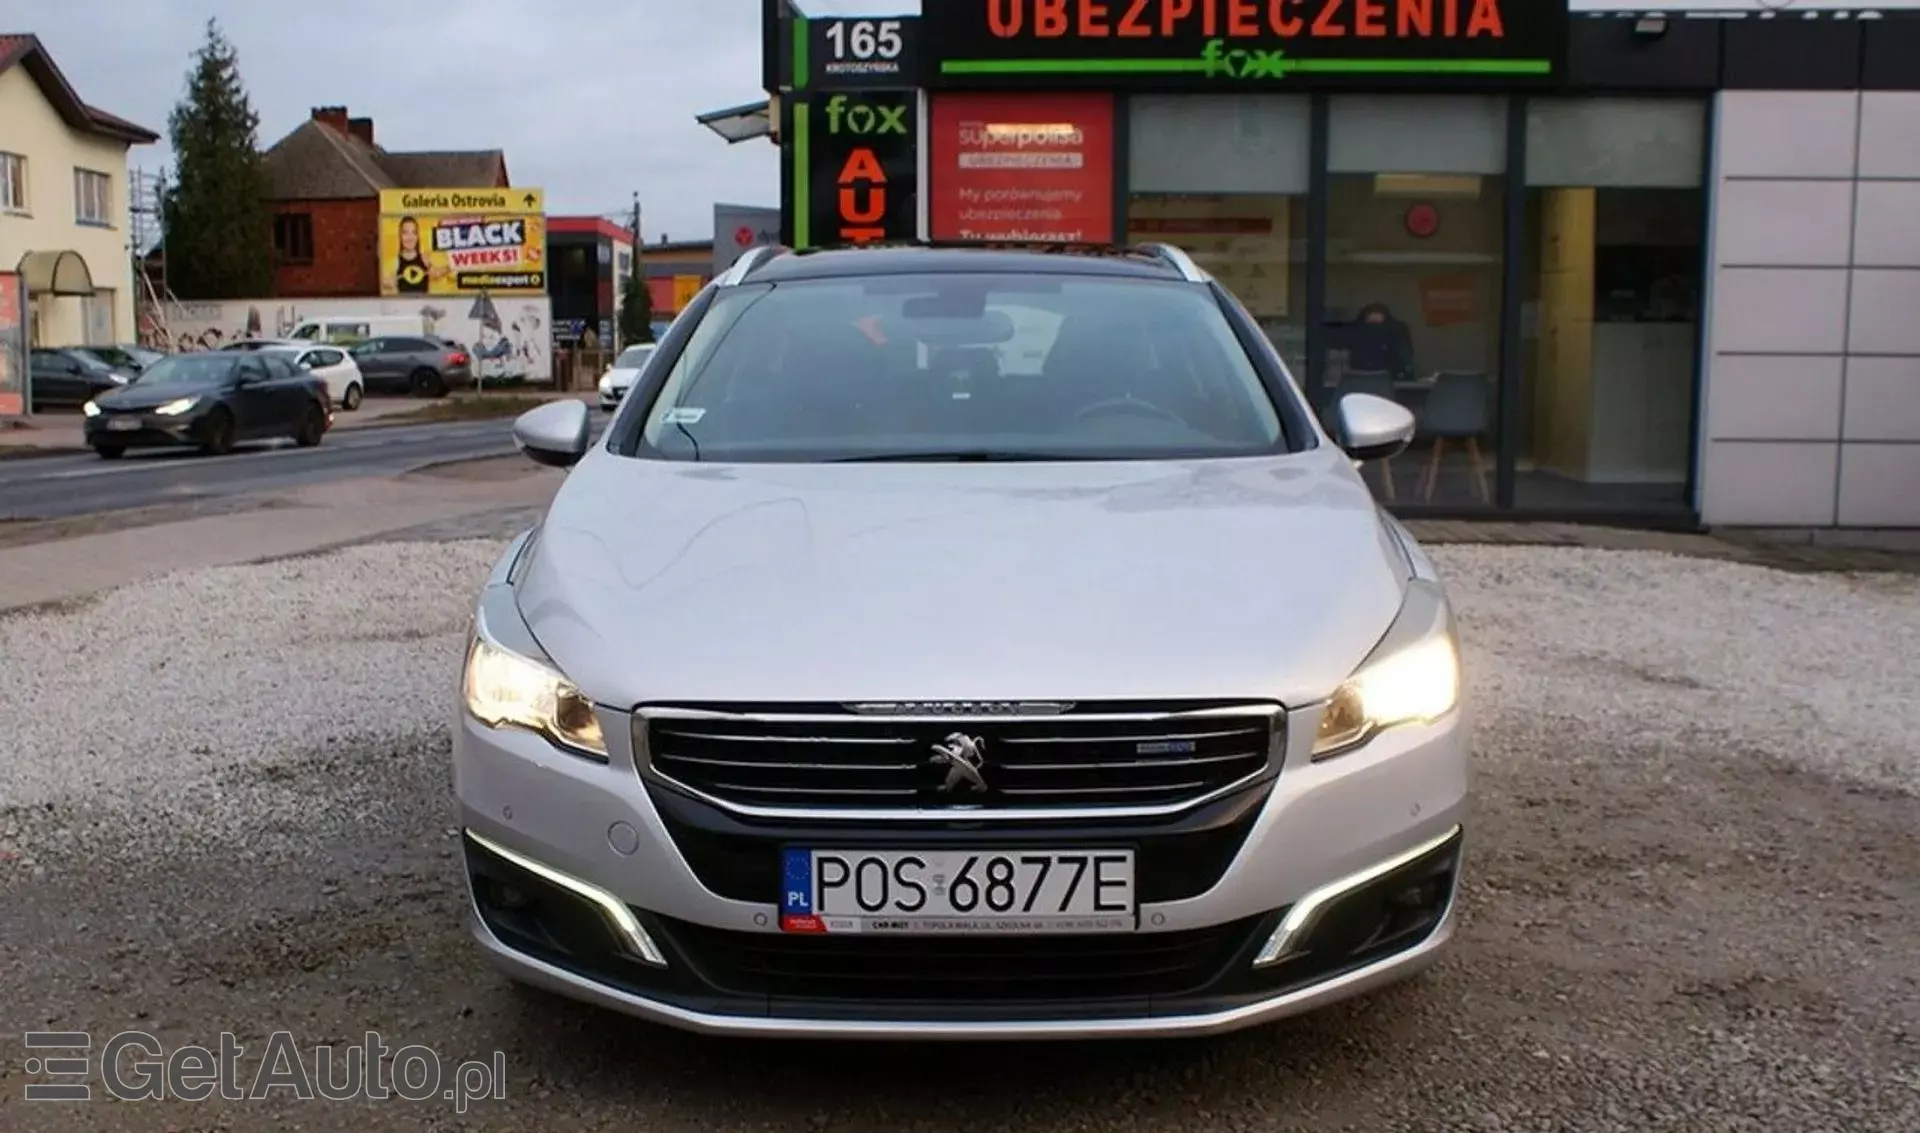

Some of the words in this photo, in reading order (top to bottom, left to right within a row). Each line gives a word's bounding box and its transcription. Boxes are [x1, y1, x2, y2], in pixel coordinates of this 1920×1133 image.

[988, 0, 1504, 38] UBEZPIECZENIA
[826, 21, 902, 59] 165
[825, 95, 908, 134] fox
[402, 192, 449, 208] Galeria
[451, 192, 506, 208] Ostrovia
[436, 220, 522, 249] BLACK
[452, 248, 518, 267] WEEKS!
[787, 891, 809, 907] PL
[816, 856, 927, 913] POS
[949, 856, 1128, 913] 6877E
